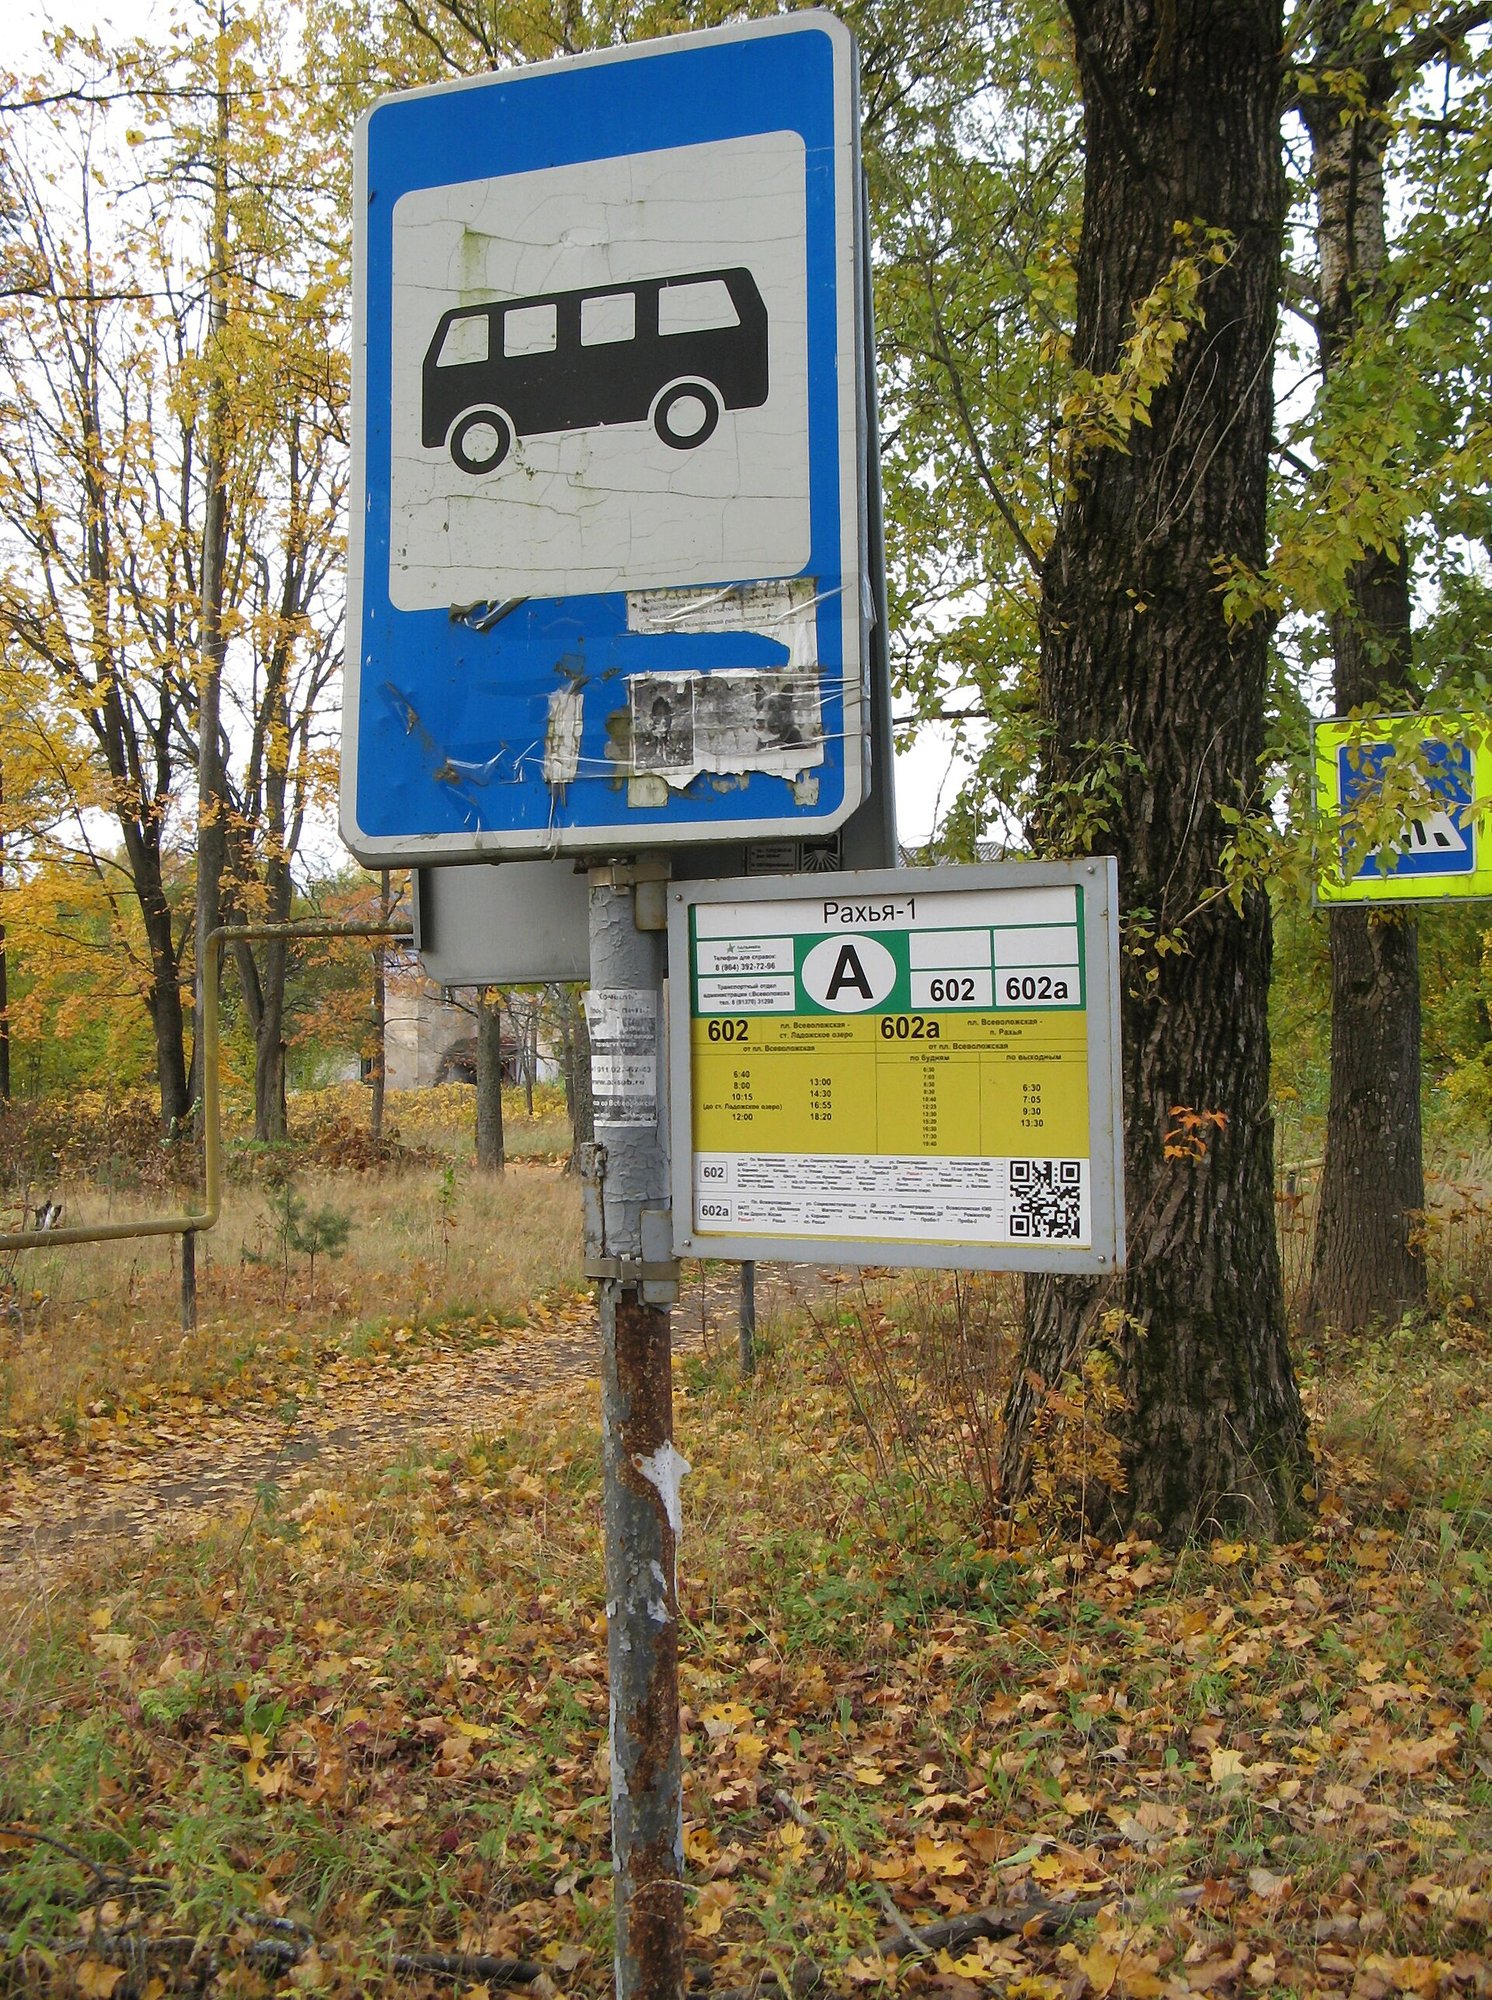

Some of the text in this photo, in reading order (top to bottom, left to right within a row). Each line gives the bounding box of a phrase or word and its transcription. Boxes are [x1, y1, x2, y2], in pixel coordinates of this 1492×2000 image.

[823, 898, 917, 924] Рахья-1
[825, 944, 874, 1000] А
[930, 978, 975, 1002] 602
[1006, 976, 1068, 1001] 602а
[708, 1019, 749, 1042] 602
[881, 1016, 940, 1039] 602а
[791, 1032, 830, 1040] Ладожское
[922, 1054, 950, 1062] будням
[1018, 1054, 1062, 1062] выходным
[734, 1070, 750, 1078] 6:40
[1022, 1084, 1041, 1092] 6:30
[1022, 1096, 1041, 1104] 7:05
[724, 1103, 760, 1111] Ладожское
[761, 1104, 783, 1112] озеро)
[1022, 1108, 1041, 1116] 9:30
[1021, 1119, 1044, 1128] 13:30
[704, 1166, 724, 1178] 602
[702, 1205, 728, 1216] 602а
